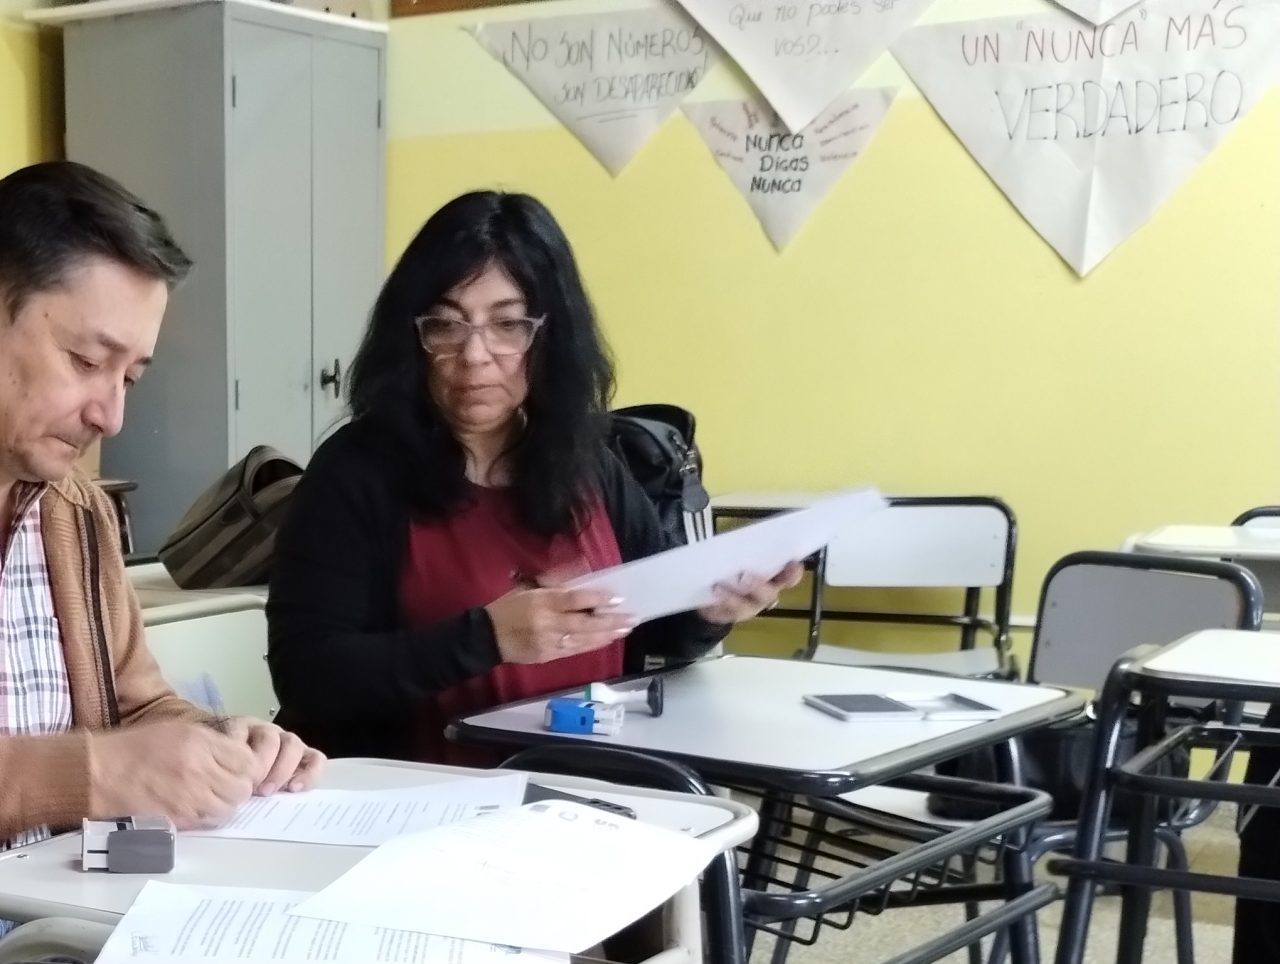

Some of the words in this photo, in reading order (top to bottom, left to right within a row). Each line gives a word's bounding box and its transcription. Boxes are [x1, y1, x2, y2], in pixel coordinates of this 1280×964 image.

[962, 31, 1000, 66] UN
[1165, 0, 1248, 52] MÁS
[994, 70, 1244, 141] VERDADERO
